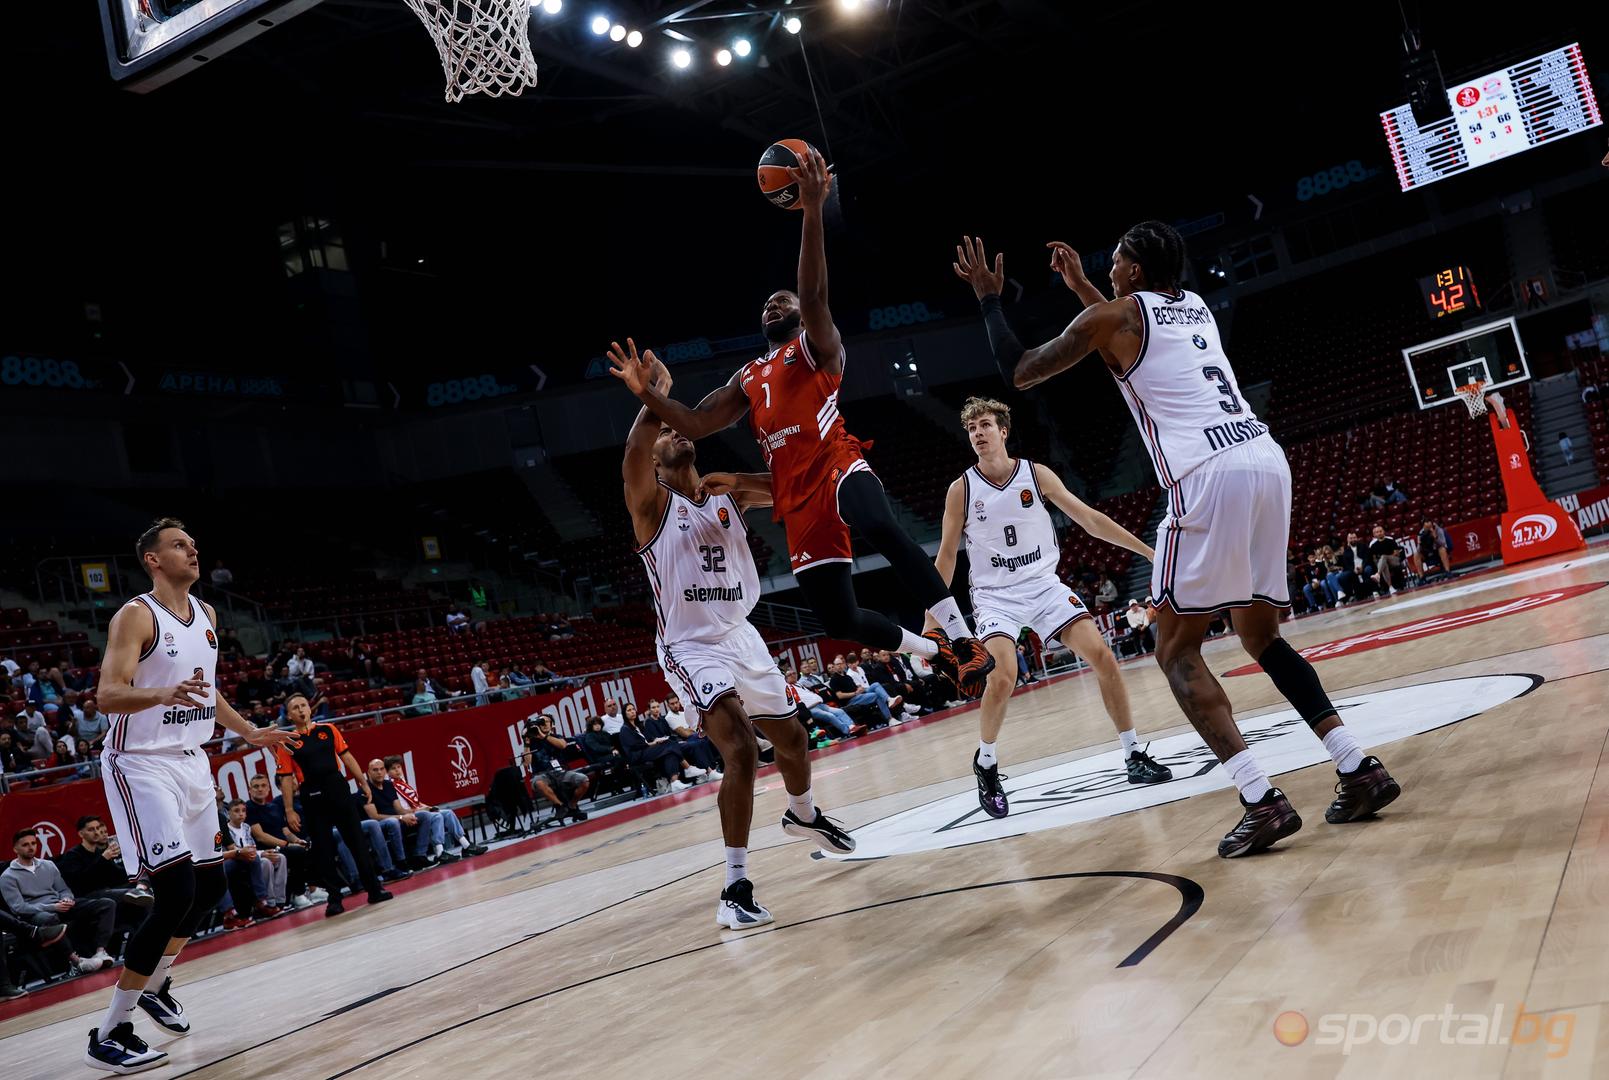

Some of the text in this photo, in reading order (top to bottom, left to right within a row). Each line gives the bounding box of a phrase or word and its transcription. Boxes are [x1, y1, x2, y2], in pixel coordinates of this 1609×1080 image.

[1477, 104, 1499, 120] 1:31
[1468, 113, 1511, 134] 54 66
[1473, 125, 1512, 145] 5 3 3
[1437, 266, 1463, 287] 1:31
[1431, 284, 1464, 310] 4.2
[1152, 306, 1212, 326] BEAUCHAMP
[761, 382, 771, 409] 1
[1203, 366, 1244, 415] 3
[767, 424, 801, 443] INVESTMENT
[1004, 524, 1017, 547] 8
[699, 545, 727, 572] 32
[991, 545, 1041, 572] siegmund
[89, 573, 104, 583] 102
[163, 704, 216, 726] siegmun
